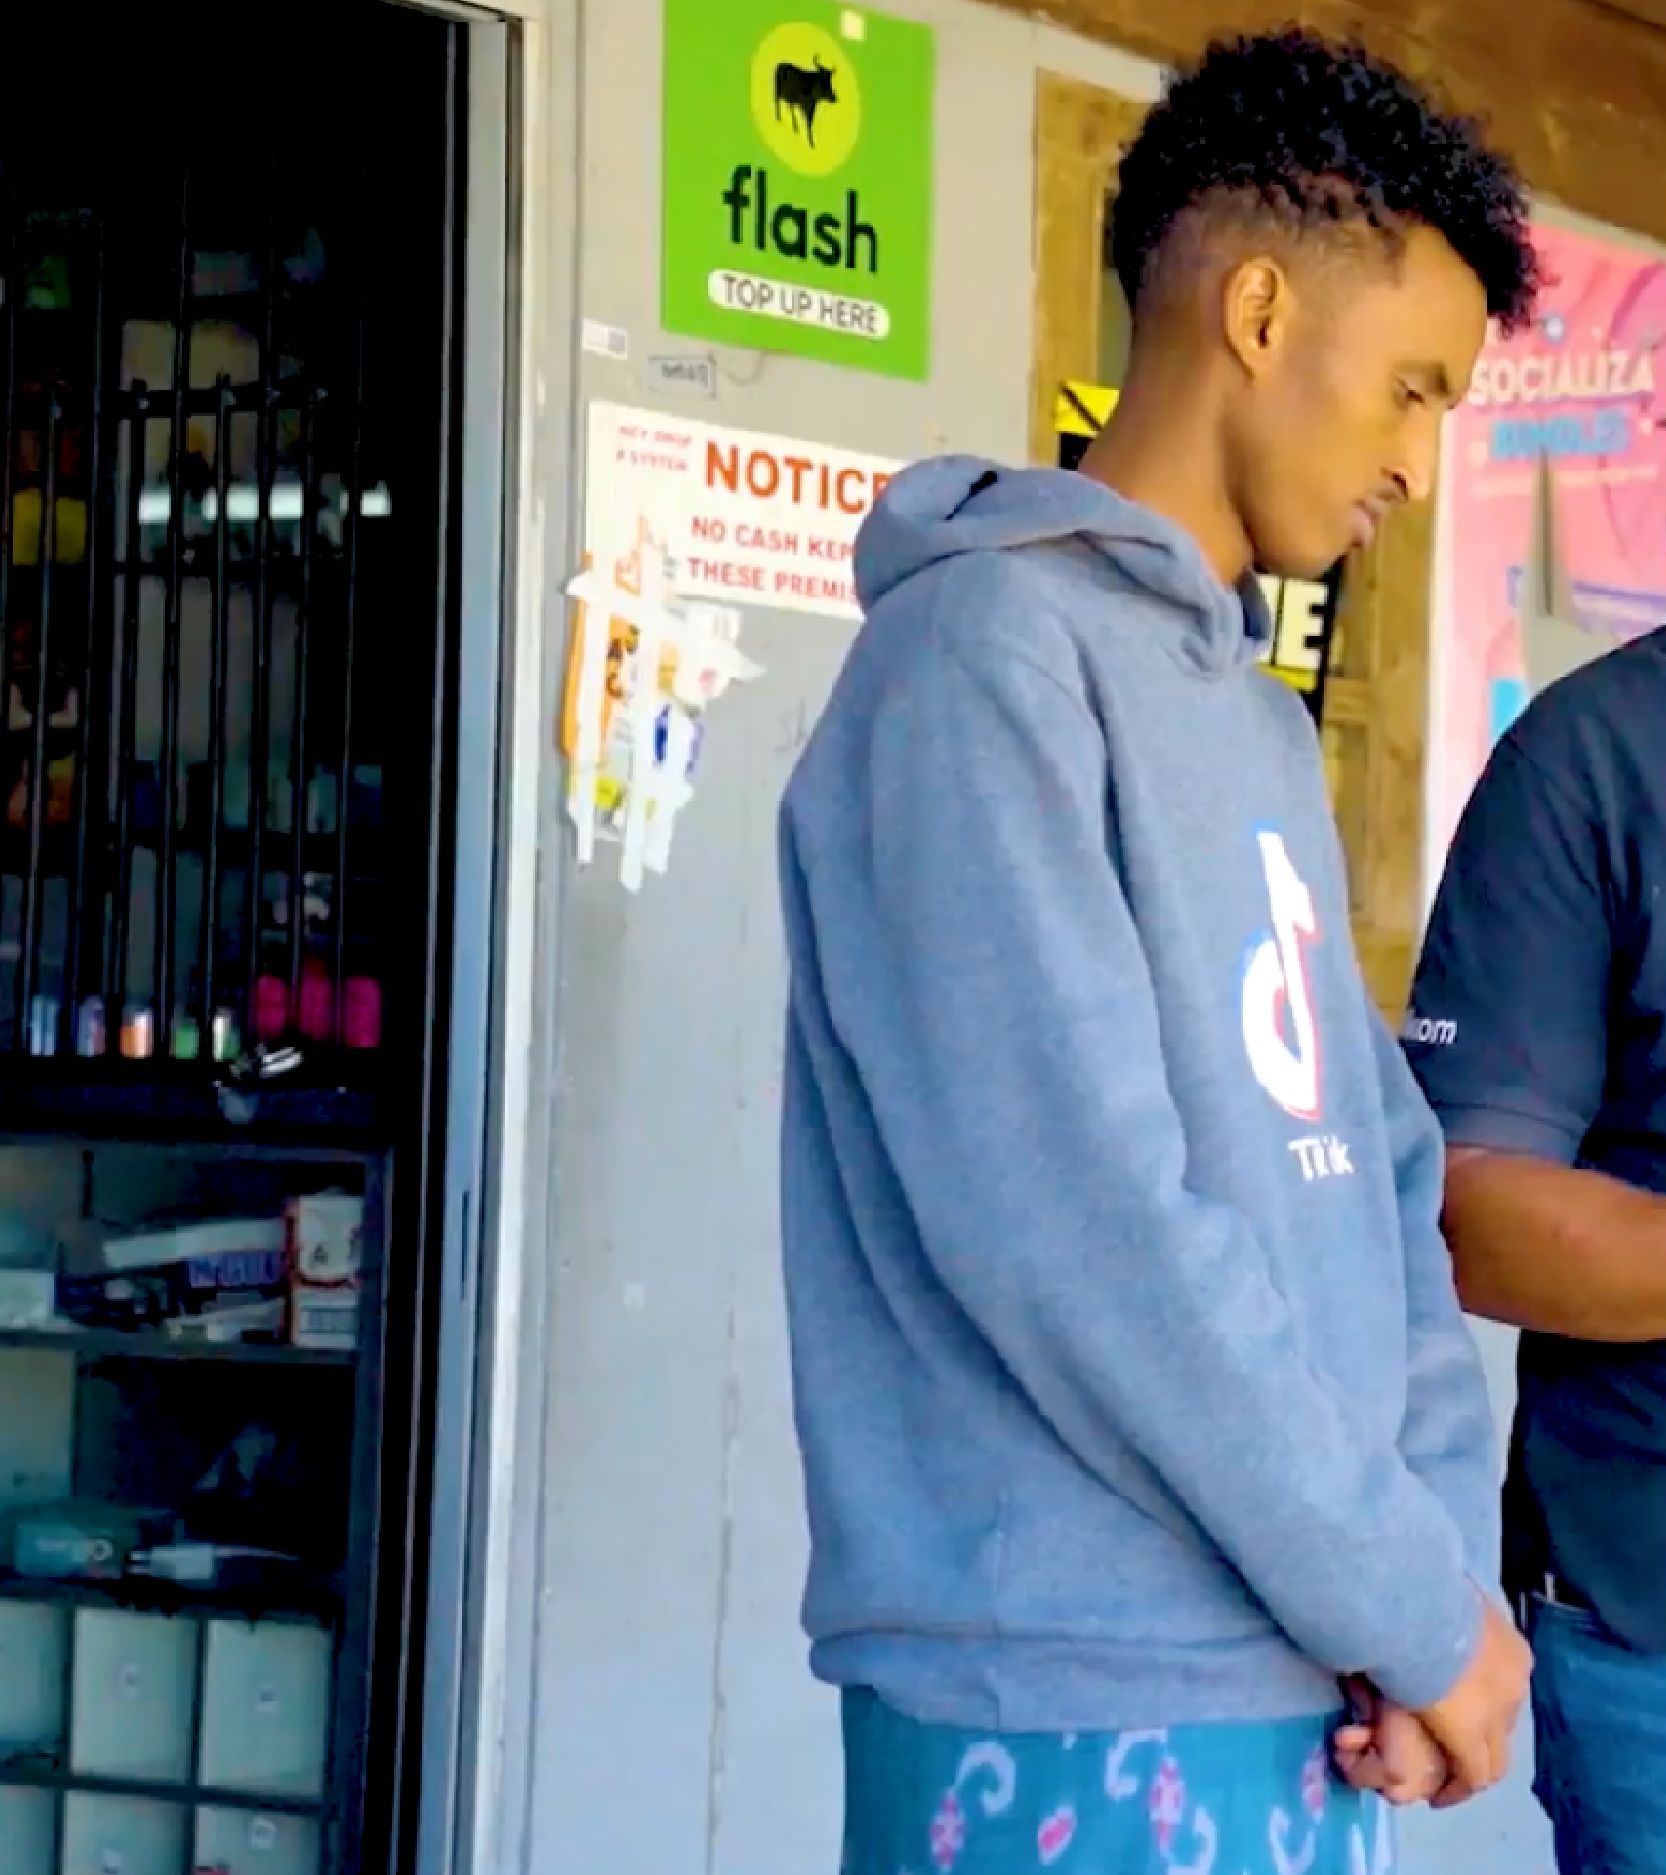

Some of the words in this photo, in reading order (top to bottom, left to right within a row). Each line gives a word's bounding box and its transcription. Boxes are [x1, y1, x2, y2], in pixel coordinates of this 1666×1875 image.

[722, 163, 878, 273] flash
[723, 273, 774, 310] TOP
[779, 286, 812, 318] UP
[818, 295, 877, 333] HERE
[690, 515, 726, 543] NO
[734, 523, 798, 555] CASH
[687, 556, 766, 592] THESE
[773, 571, 858, 603] PREMI
